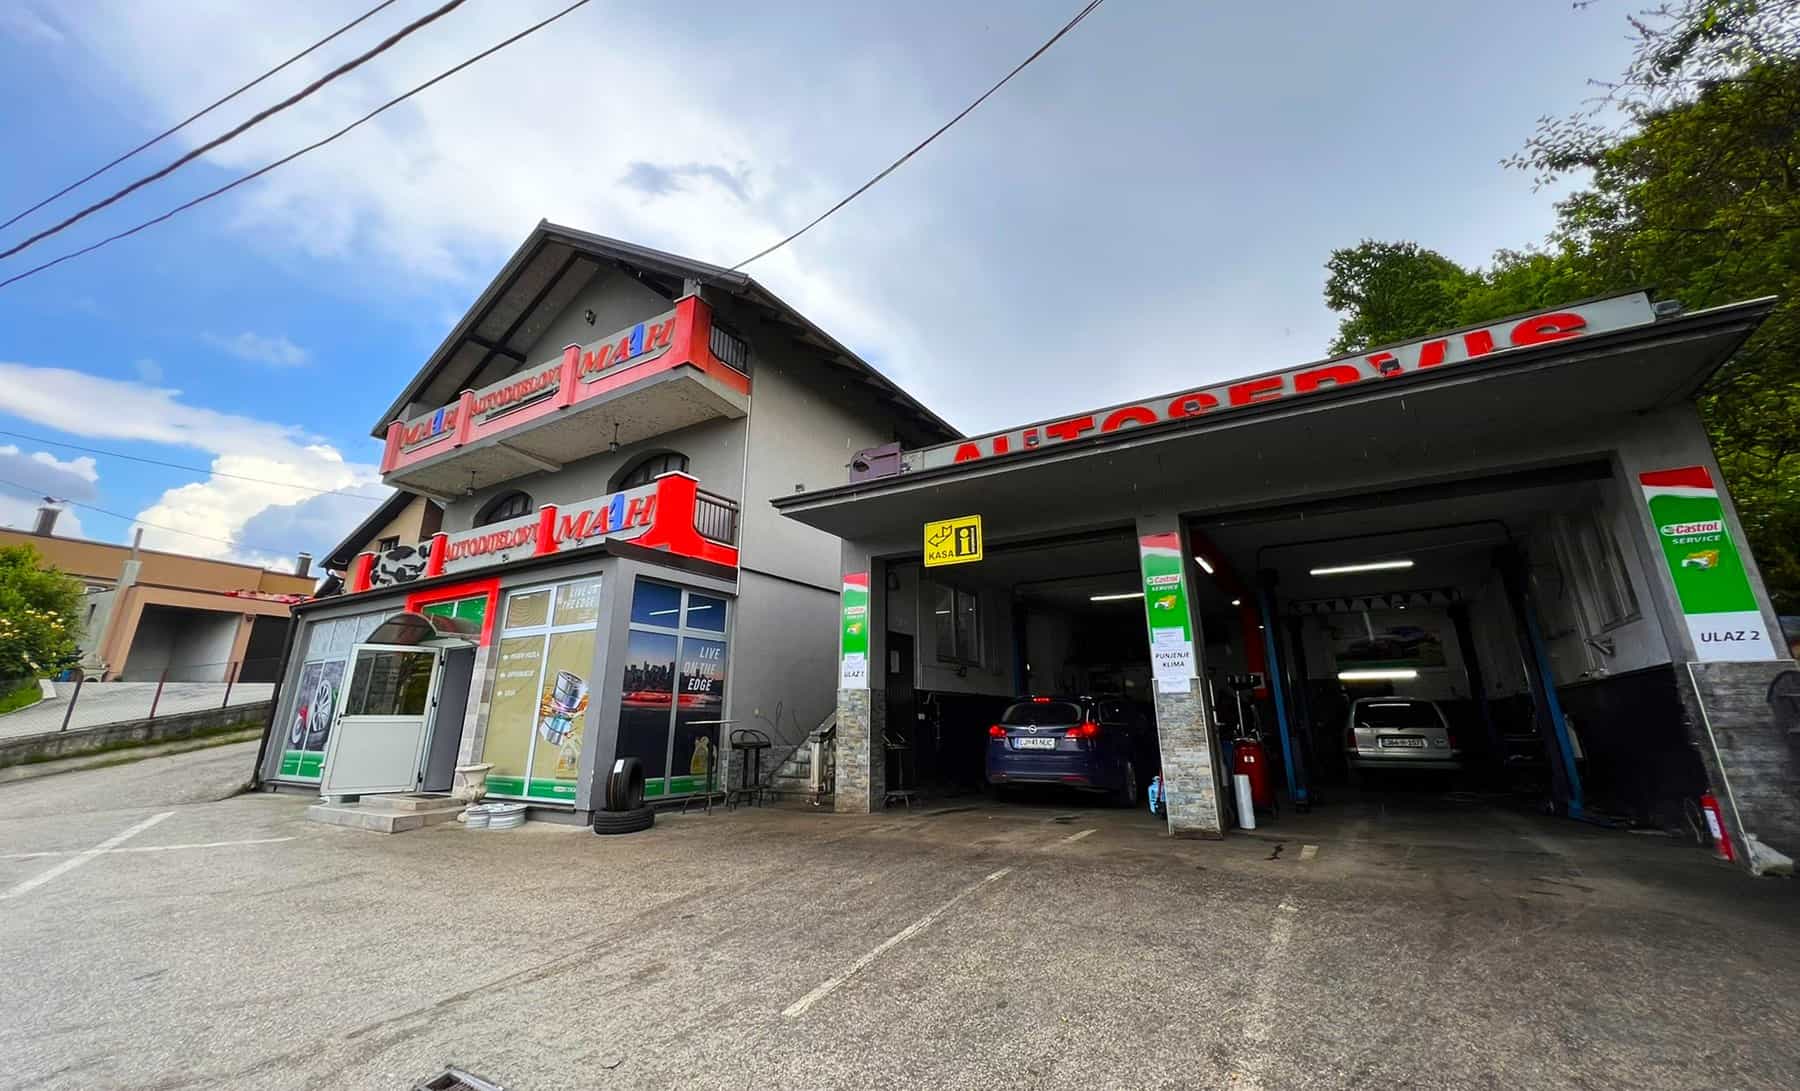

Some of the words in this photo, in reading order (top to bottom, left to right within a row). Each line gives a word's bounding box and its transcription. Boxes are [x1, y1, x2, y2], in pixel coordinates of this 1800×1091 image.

[1676, 521, 1719, 534] Castrol
[1672, 535, 1721, 545] SERVICE
[928, 551, 954, 561] KASA
[1700, 631, 1746, 643] ULAZ
[1750, 630, 1761, 641] 2
[699, 646, 721, 660] LIVE
[1162, 660, 1185, 668] KLIMA
[687, 678, 713, 692] EDGE
